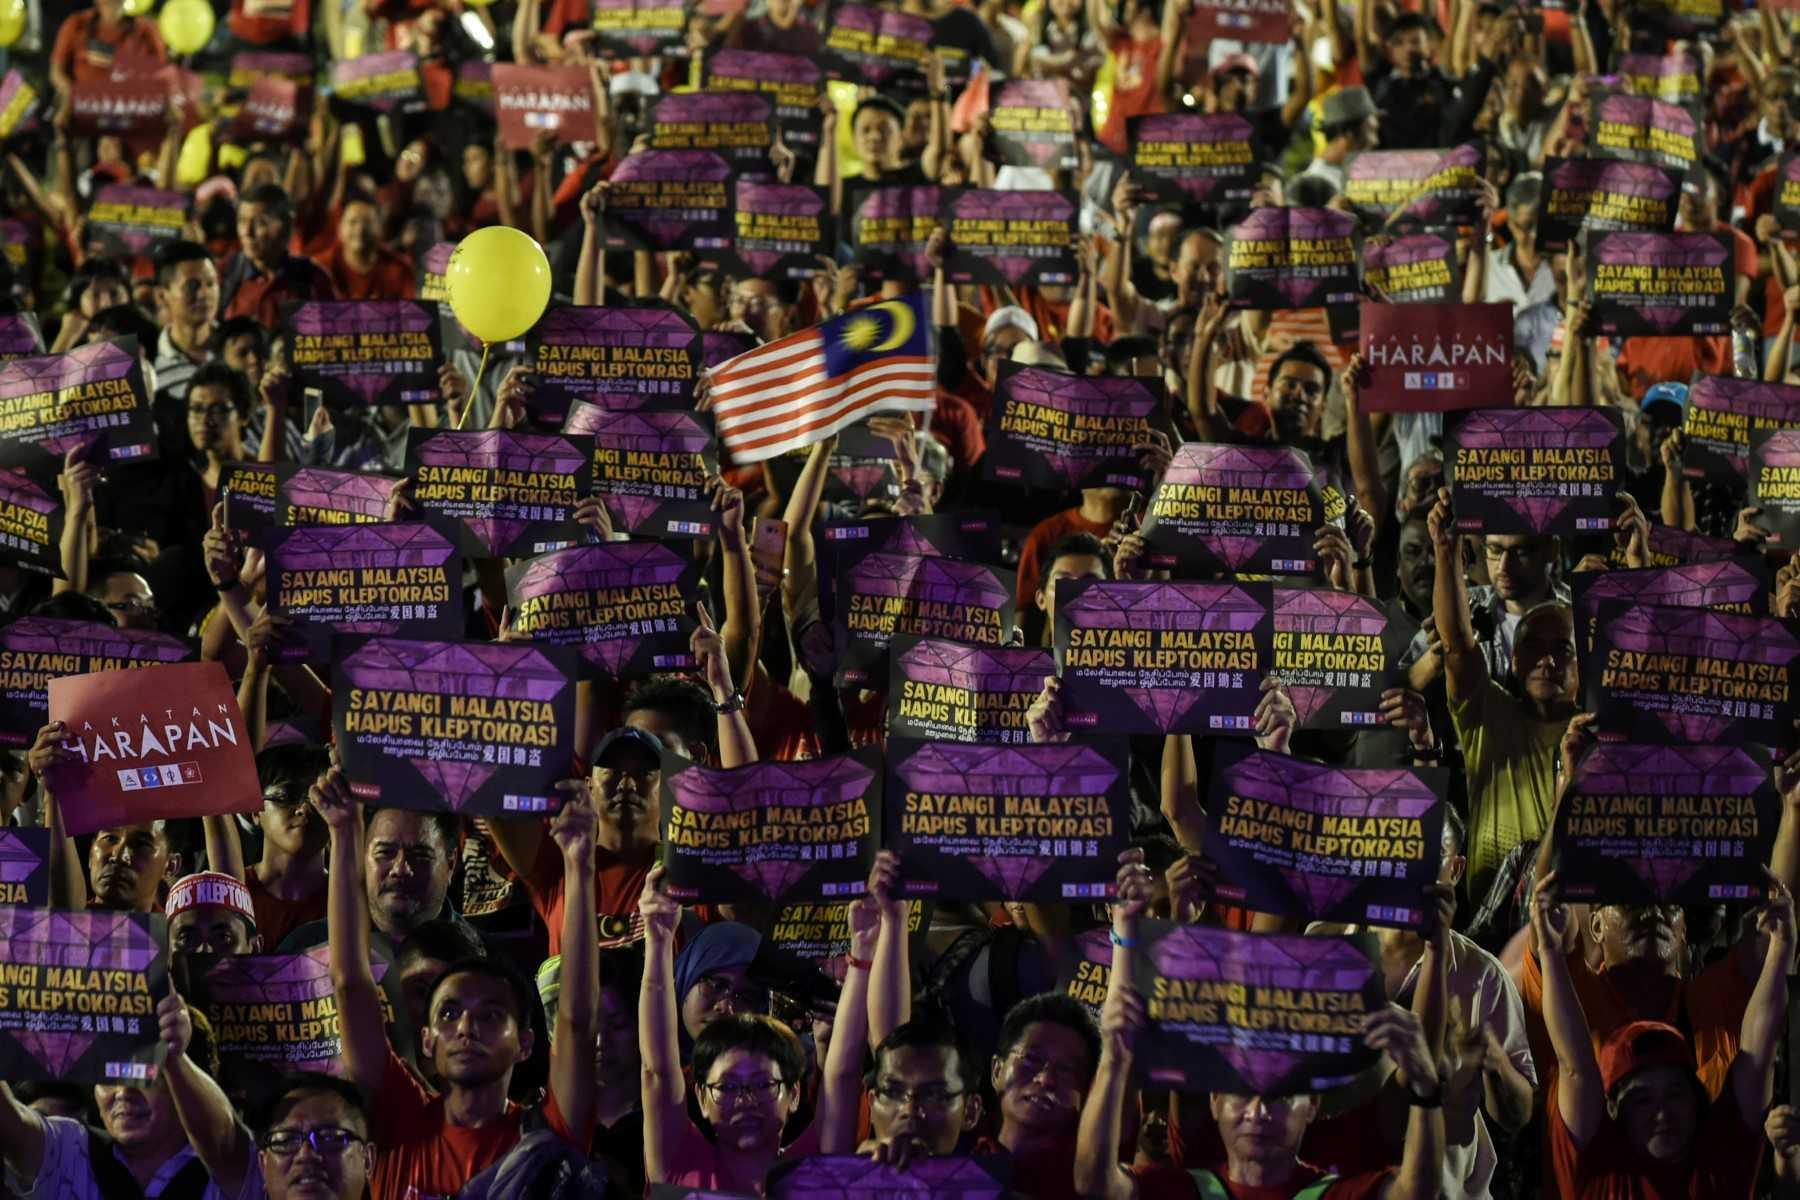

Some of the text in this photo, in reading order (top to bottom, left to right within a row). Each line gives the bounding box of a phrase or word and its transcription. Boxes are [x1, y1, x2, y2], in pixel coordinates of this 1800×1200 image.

[538, 345, 689, 363] SAYANGI MALAYSIA
[1369, 342, 1505, 367] HARAPAN
[536, 361, 692, 379] HAPUS KLEPTOKRASI
[59, 378, 132, 405] MALAYSIA
[40, 394, 137, 424] KLEPTOKRASI
[1006, 400, 1149, 433] SAYANGI MALAYSIA
[1689, 406, 1749, 428] SAYANGI
[1001, 416, 1150, 447] HAPUS KLEPTOKRASI
[1684, 420, 1729, 440] HAPUS
[627, 451, 705, 470] MALAYSIA
[1457, 449, 1611, 465] SAYANGI MALAYSIA
[418, 466, 576, 491] SAYANGI MALAYSIA
[1454, 465, 1614, 481] HAPUS KLEPTOKRASI
[228, 478, 276, 497] HAPUS
[415, 484, 579, 506] HAPUS KLEPTOKRASI
[1159, 484, 1222, 503] SAYANGI
[1229, 488, 1310, 506] MALAYSIA
[1152, 501, 1313, 523] HAPUS KLEPTOKRASI
[281, 567, 447, 589] SAYANGI MALAYSIA
[279, 585, 449, 607] HAPUS KLEPTOKRASI
[520, 583, 682, 618] SAYANGI MALAYSIA
[517, 600, 686, 633] HAPUS KLEPTOKRASI
[851, 595, 1001, 625] SAYANGI MALAYSIA
[848, 613, 1004, 644] HAPUS KLEPTOKRASI
[1070, 627, 1152, 649] SAYANGI
[1161, 629, 1256, 651] MALAYSIA
[1300, 633, 1383, 653] MALAYSIA
[0, 651, 81, 673] SAYANGI
[1065, 649, 1258, 671] HAPUS KLEPTOKRASI
[1275, 651, 1385, 671] KLEPTOKRASI
[1608, 649, 1789, 683] SAYANGI MALAYSIA
[904, 681, 970, 705] SAYANGI
[1601, 669, 1790, 702] HAPUS KLEPTOKRASI
[350, 689, 555, 724] SAYANGI MALAYSIA
[900, 699, 949, 722] HAPUS
[62, 717, 238, 764] HARAPAN
[345, 711, 558, 747] HAPUS KLEPTOKRASI
[672, 798, 867, 831] SAYANGI MALAYSIA
[905, 793, 1110, 817] SAYANGI MALAYSIA
[1227, 795, 1423, 838] SAYANGI MALAYSIA
[1571, 795, 1756, 817] SAYANGI MALAYSIA
[667, 816, 870, 849] HAPUS KLEPTOKRASI
[902, 815, 1113, 838] HAPUS KLEPTOKRASI
[1219, 815, 1425, 860] HAPUS KLEPTOKRASI
[1567, 817, 1759, 838] HAPUS KLEPTOKRASI
[772, 923, 824, 941] HAPUS
[47, 967, 149, 993] MALAYSIA
[16, 988, 154, 1016] KLEPTOKRASI
[1153, 977, 1365, 1012] SAYANGI MALAYSIA
[210, 1002, 293, 1023] SAYANGI
[1148, 998, 1218, 1024] HAPUS
